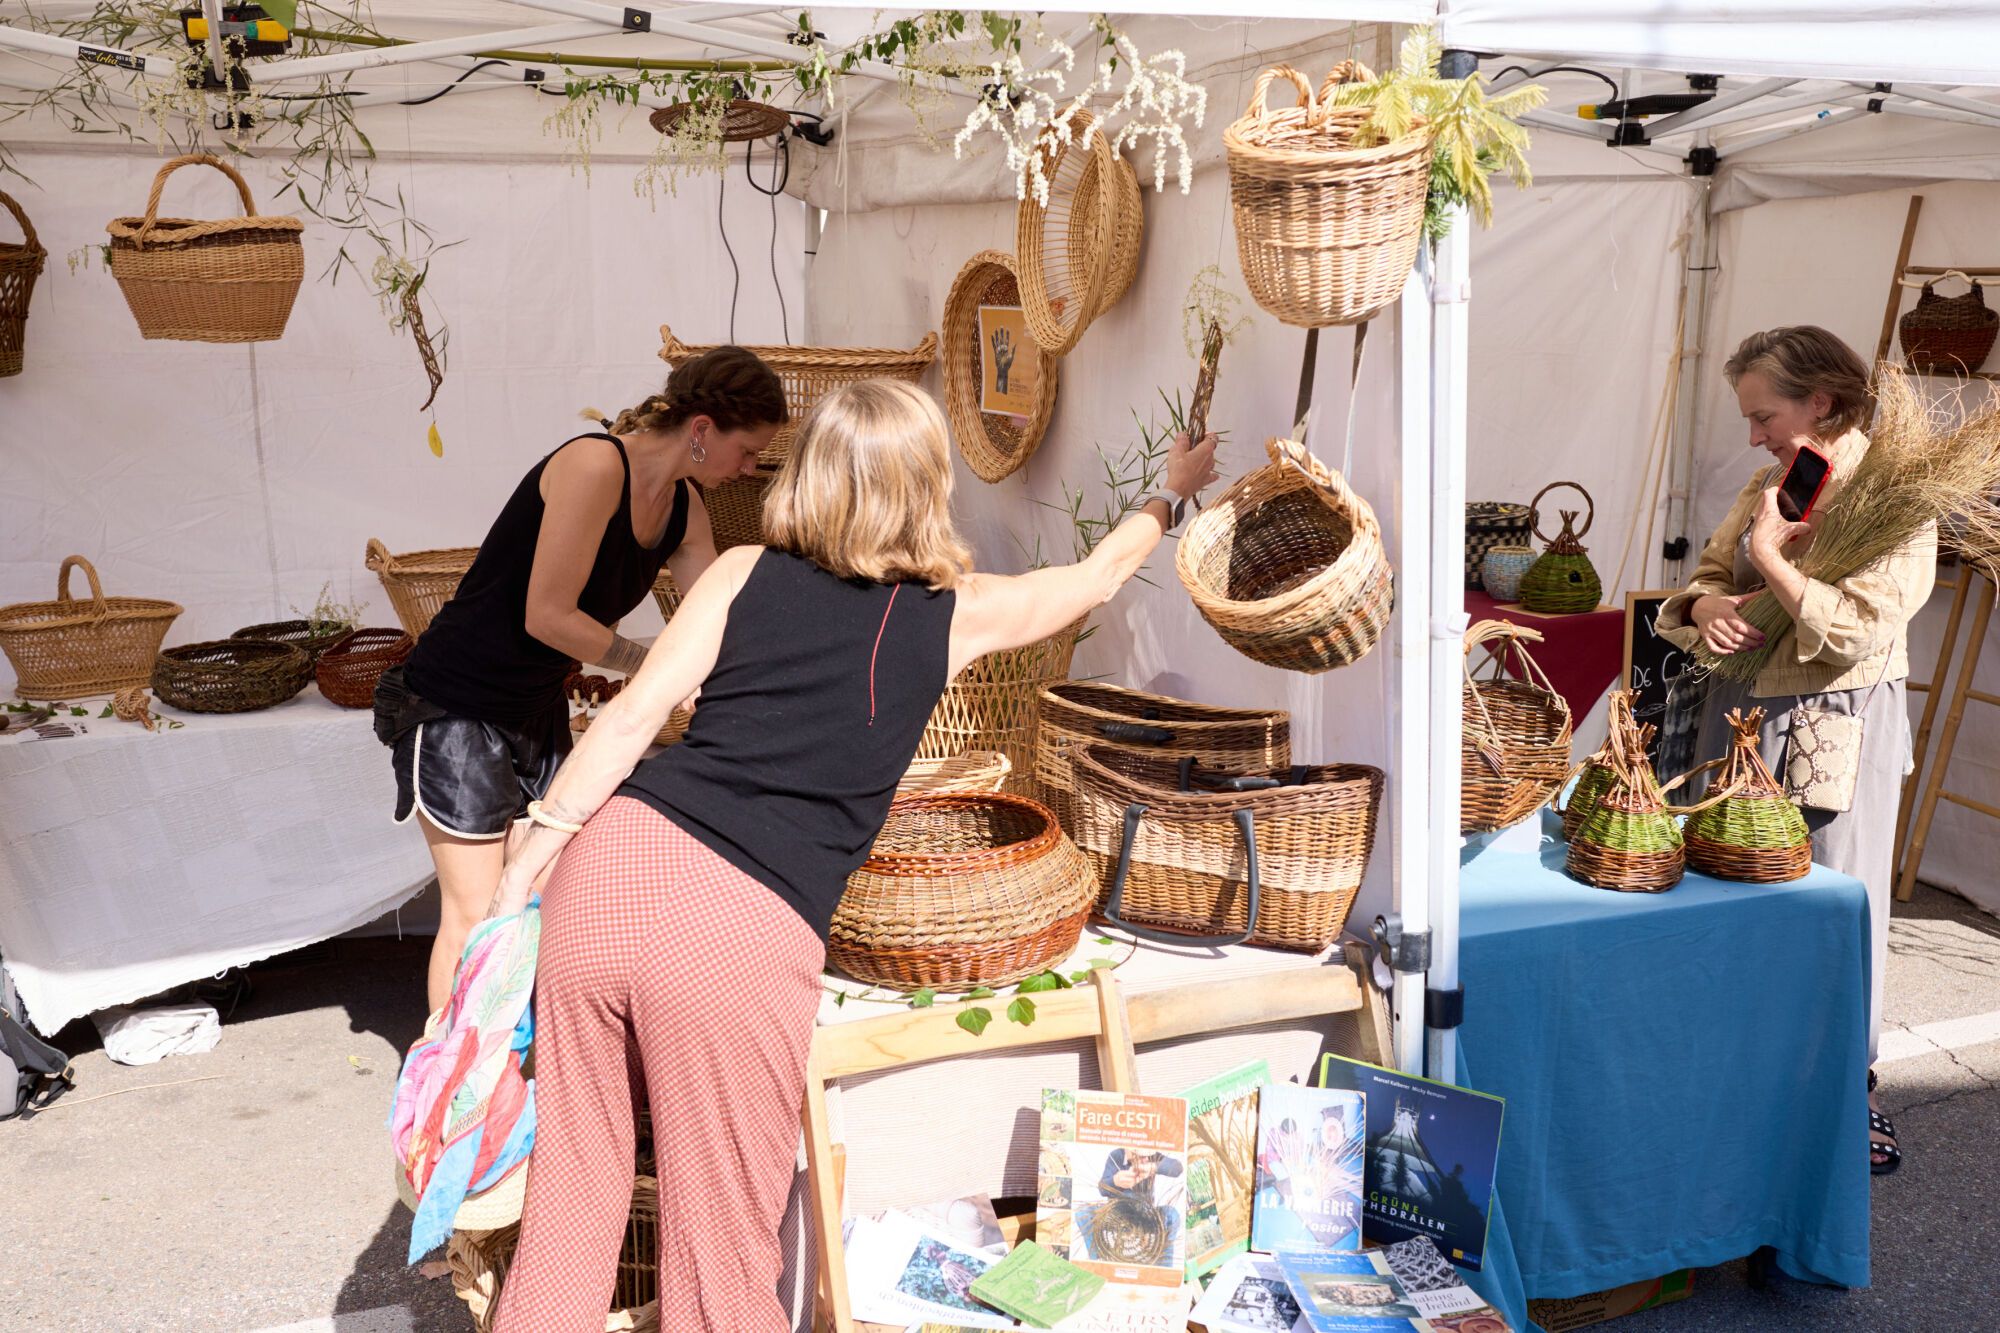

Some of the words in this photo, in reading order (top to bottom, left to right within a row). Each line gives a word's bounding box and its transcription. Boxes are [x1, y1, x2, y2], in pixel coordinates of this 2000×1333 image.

[1373, 1076, 1390, 1085] Marcel
[1190, 1074, 1265, 1119] eidenbaubuch
[1080, 1108, 1112, 1126] Fare
[1115, 1110, 1160, 1130] CESTI
[1261, 1193, 1278, 1209] LA
[1284, 1194, 1353, 1218] VNERIE
[1370, 1191, 1420, 1214] GRÜNE
[1362, 1199, 1446, 1232] THEDRALEN
[1426, 1297, 1471, 1312] Ireland
